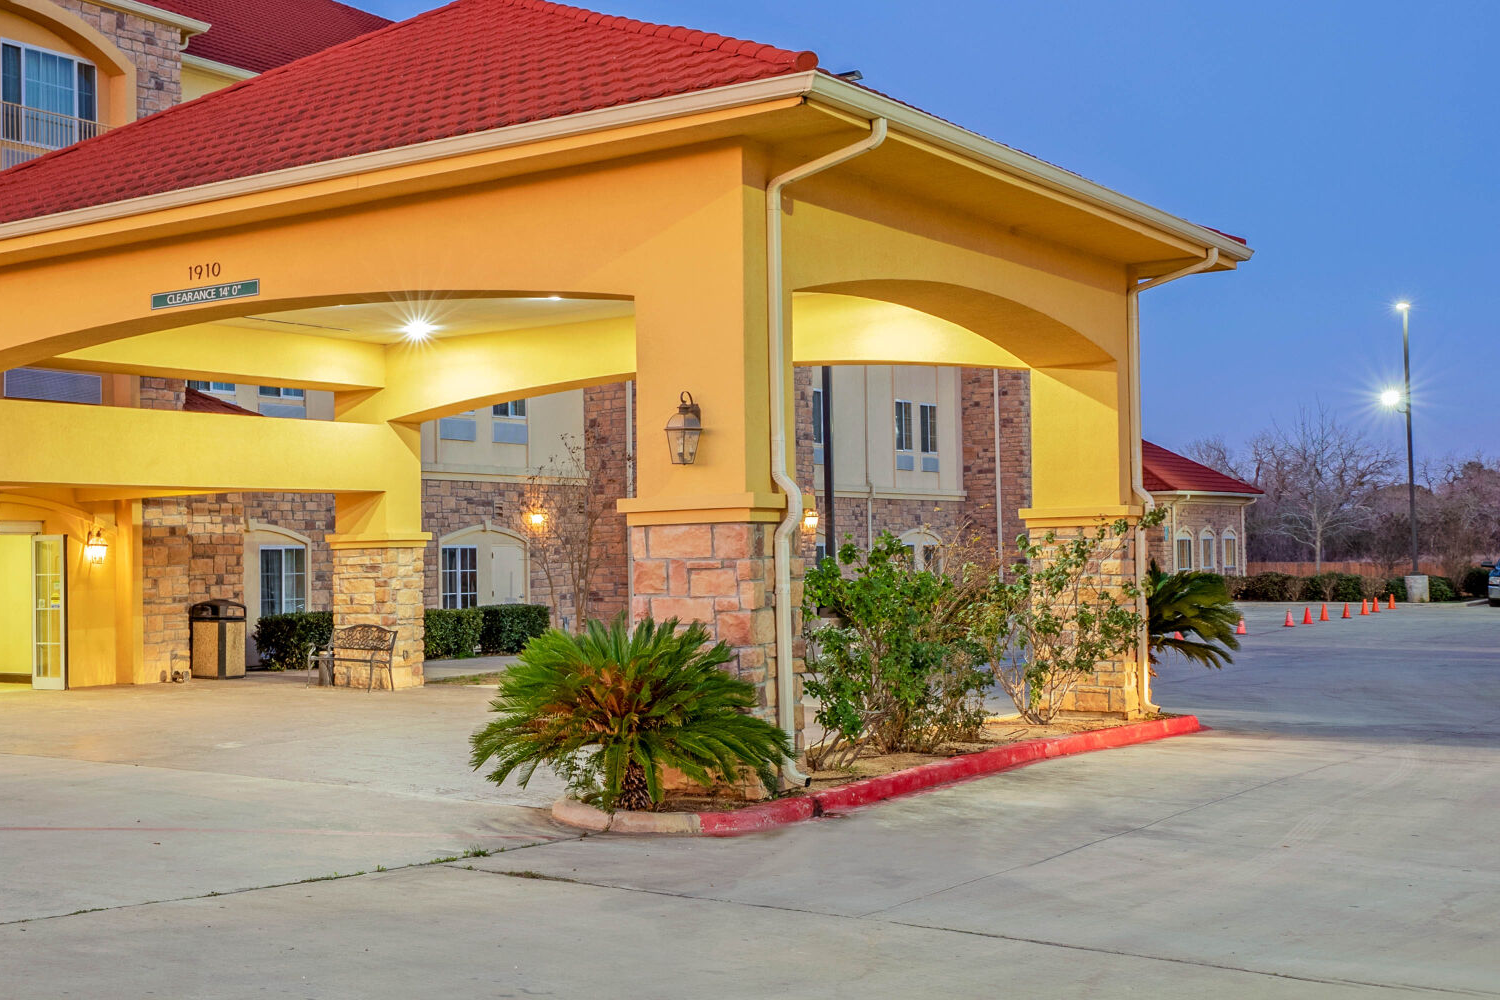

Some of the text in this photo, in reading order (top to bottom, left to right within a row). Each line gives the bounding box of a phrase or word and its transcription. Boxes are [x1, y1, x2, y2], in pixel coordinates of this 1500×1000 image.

[188, 262, 221, 281] 1910
[166, 288, 217, 305] CLEARANCE
[218, 286, 230, 298] 14'
